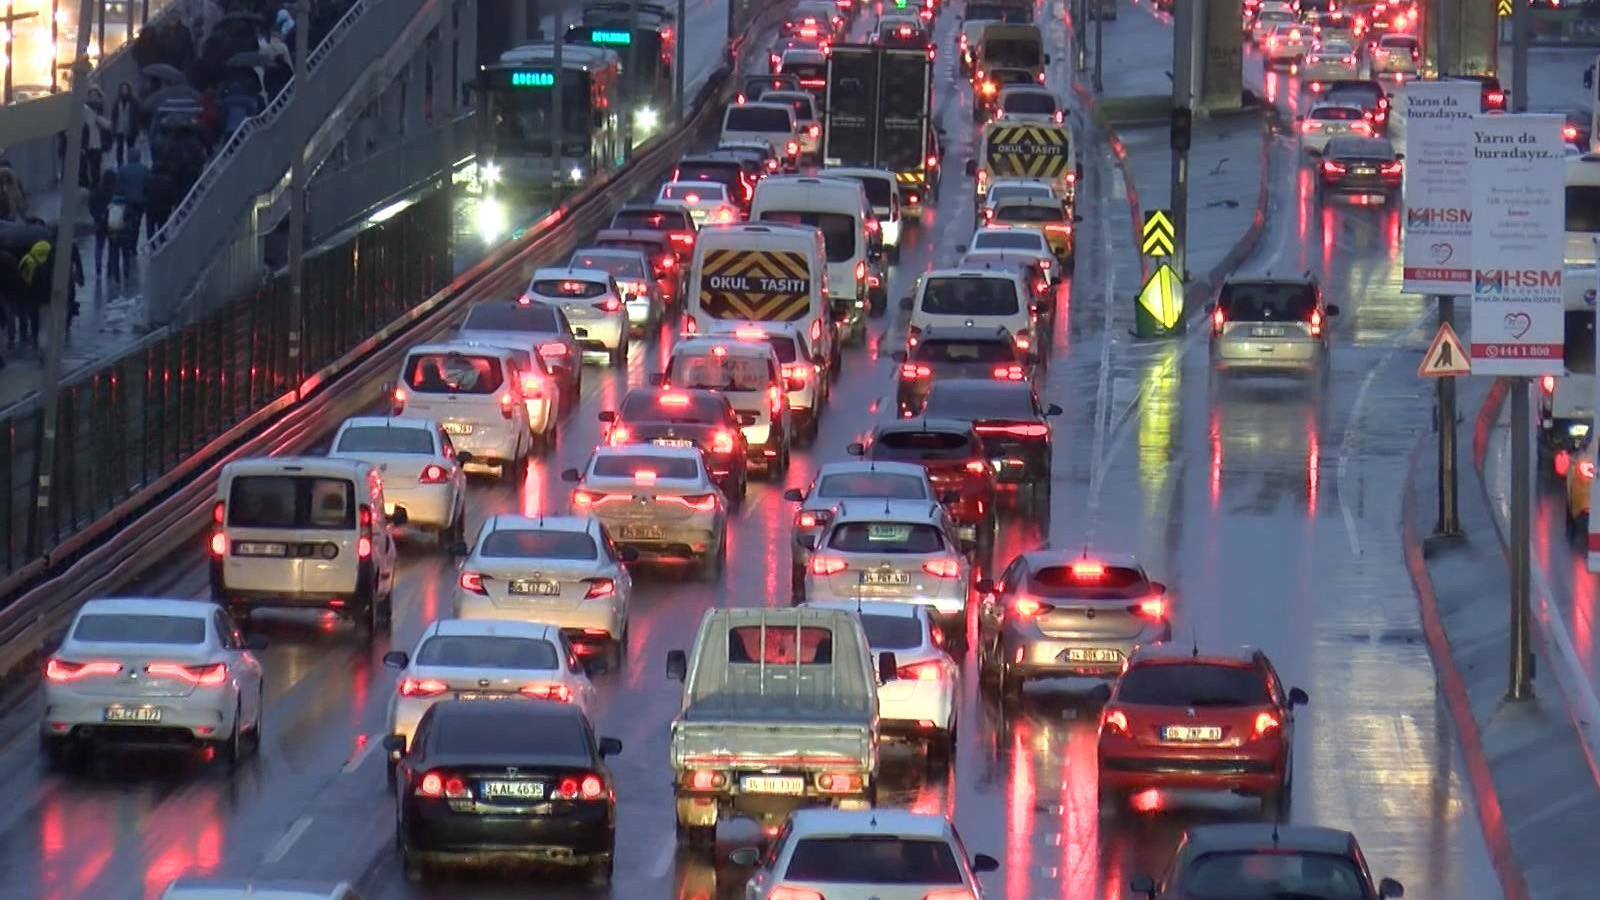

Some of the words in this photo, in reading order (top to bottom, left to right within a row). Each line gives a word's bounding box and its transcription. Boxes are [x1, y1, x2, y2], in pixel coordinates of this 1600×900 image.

[1442, 95, 1458, 106] da
[1475, 131, 1514, 143] Yarın
[1518, 132, 1536, 143] da
[998, 145, 1023, 153] OKUL
[1475, 147, 1565, 162] buradayız...
[710, 276, 750, 290] OKUL
[1503, 270, 1561, 287] HSM
[1501, 346, 1518, 356] 444
[1530, 346, 1550, 356] 800
[486, 783, 498, 796] 34
[500, 783, 513, 795] AL
